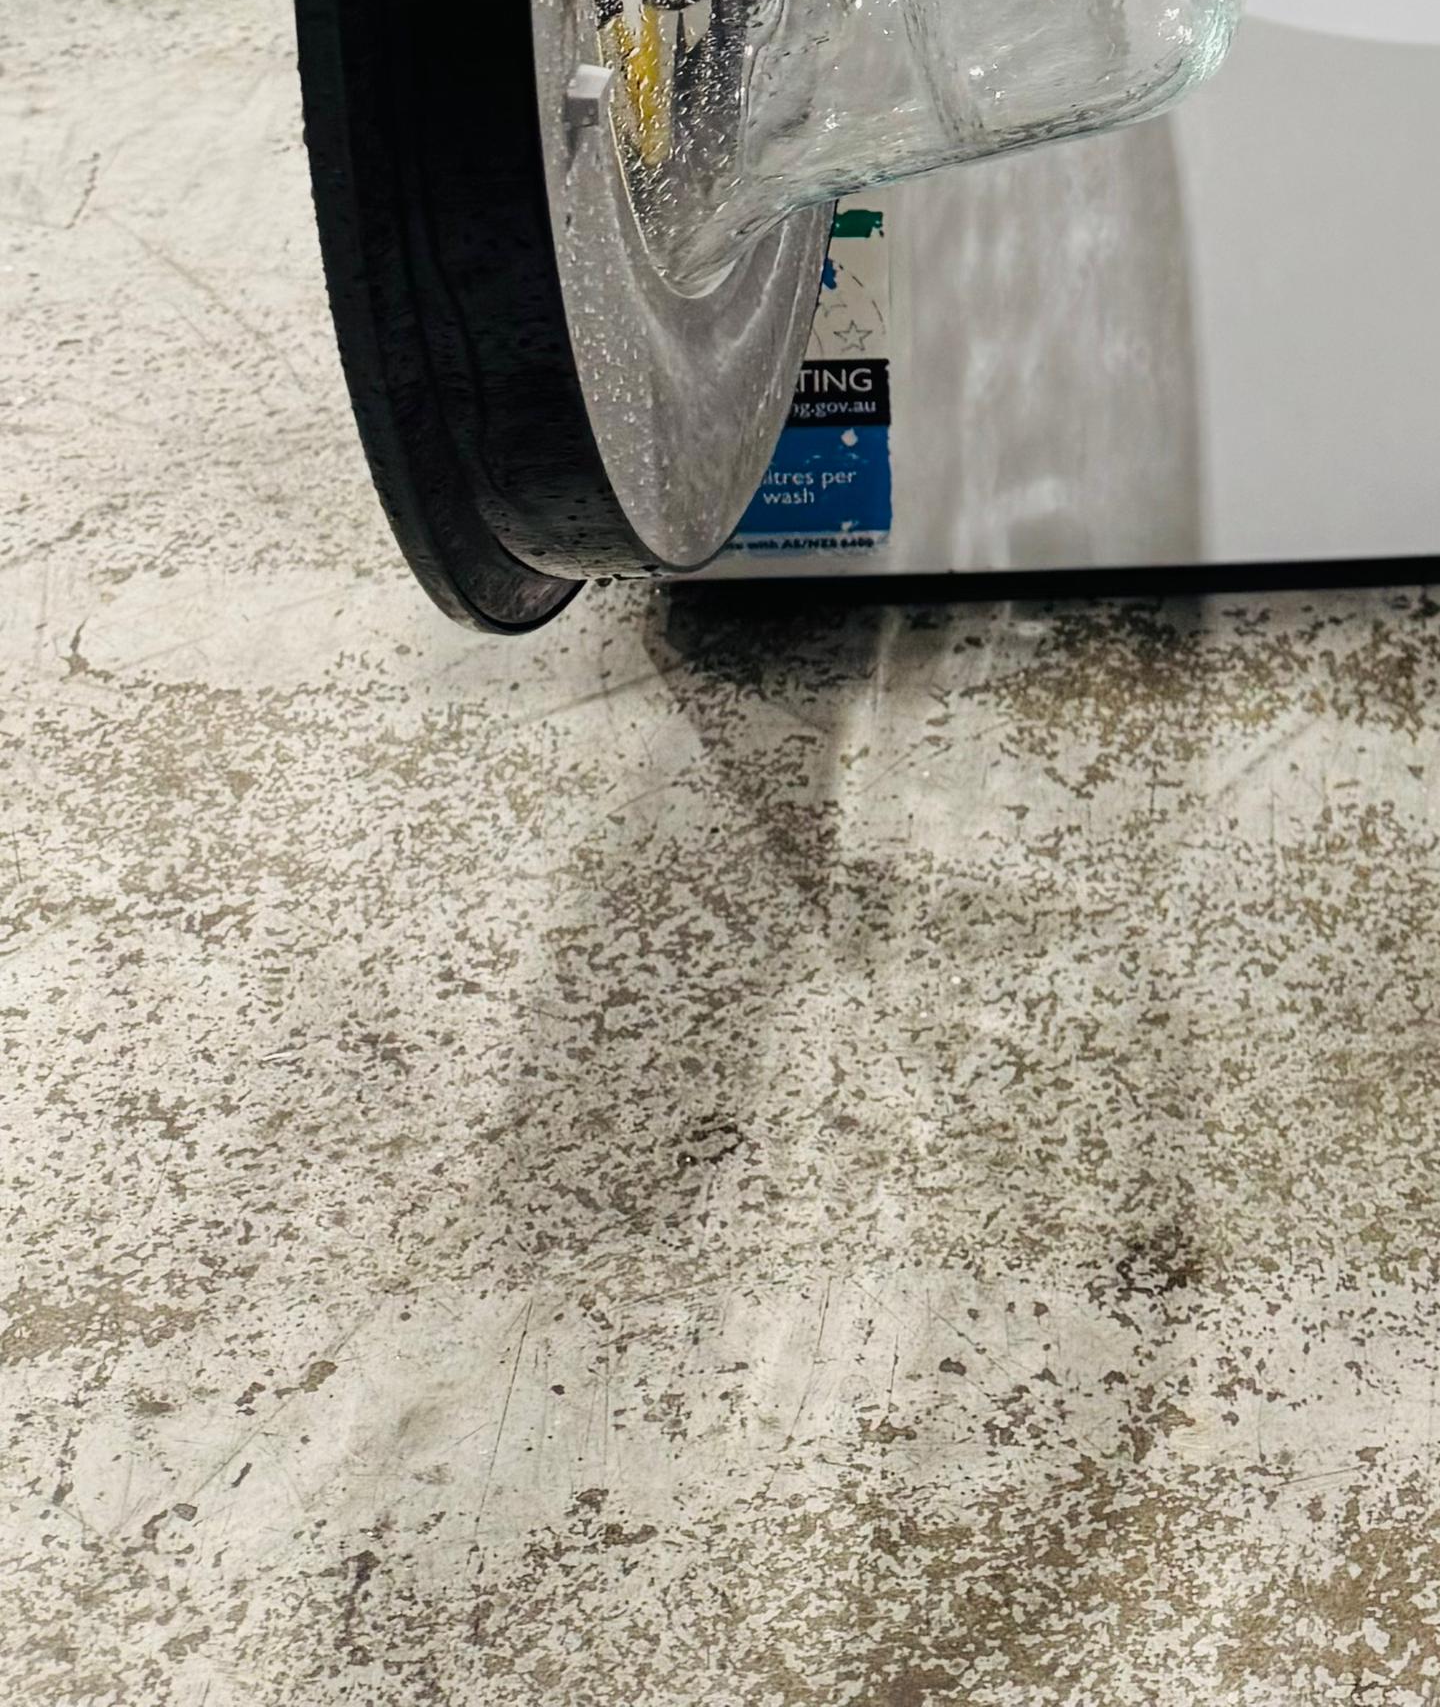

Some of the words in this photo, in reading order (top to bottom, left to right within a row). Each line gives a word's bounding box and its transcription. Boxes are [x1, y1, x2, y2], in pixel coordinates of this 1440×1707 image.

[796, 368, 873, 393] TING
[822, 471, 857, 489] per
[763, 488, 815, 505] wash
